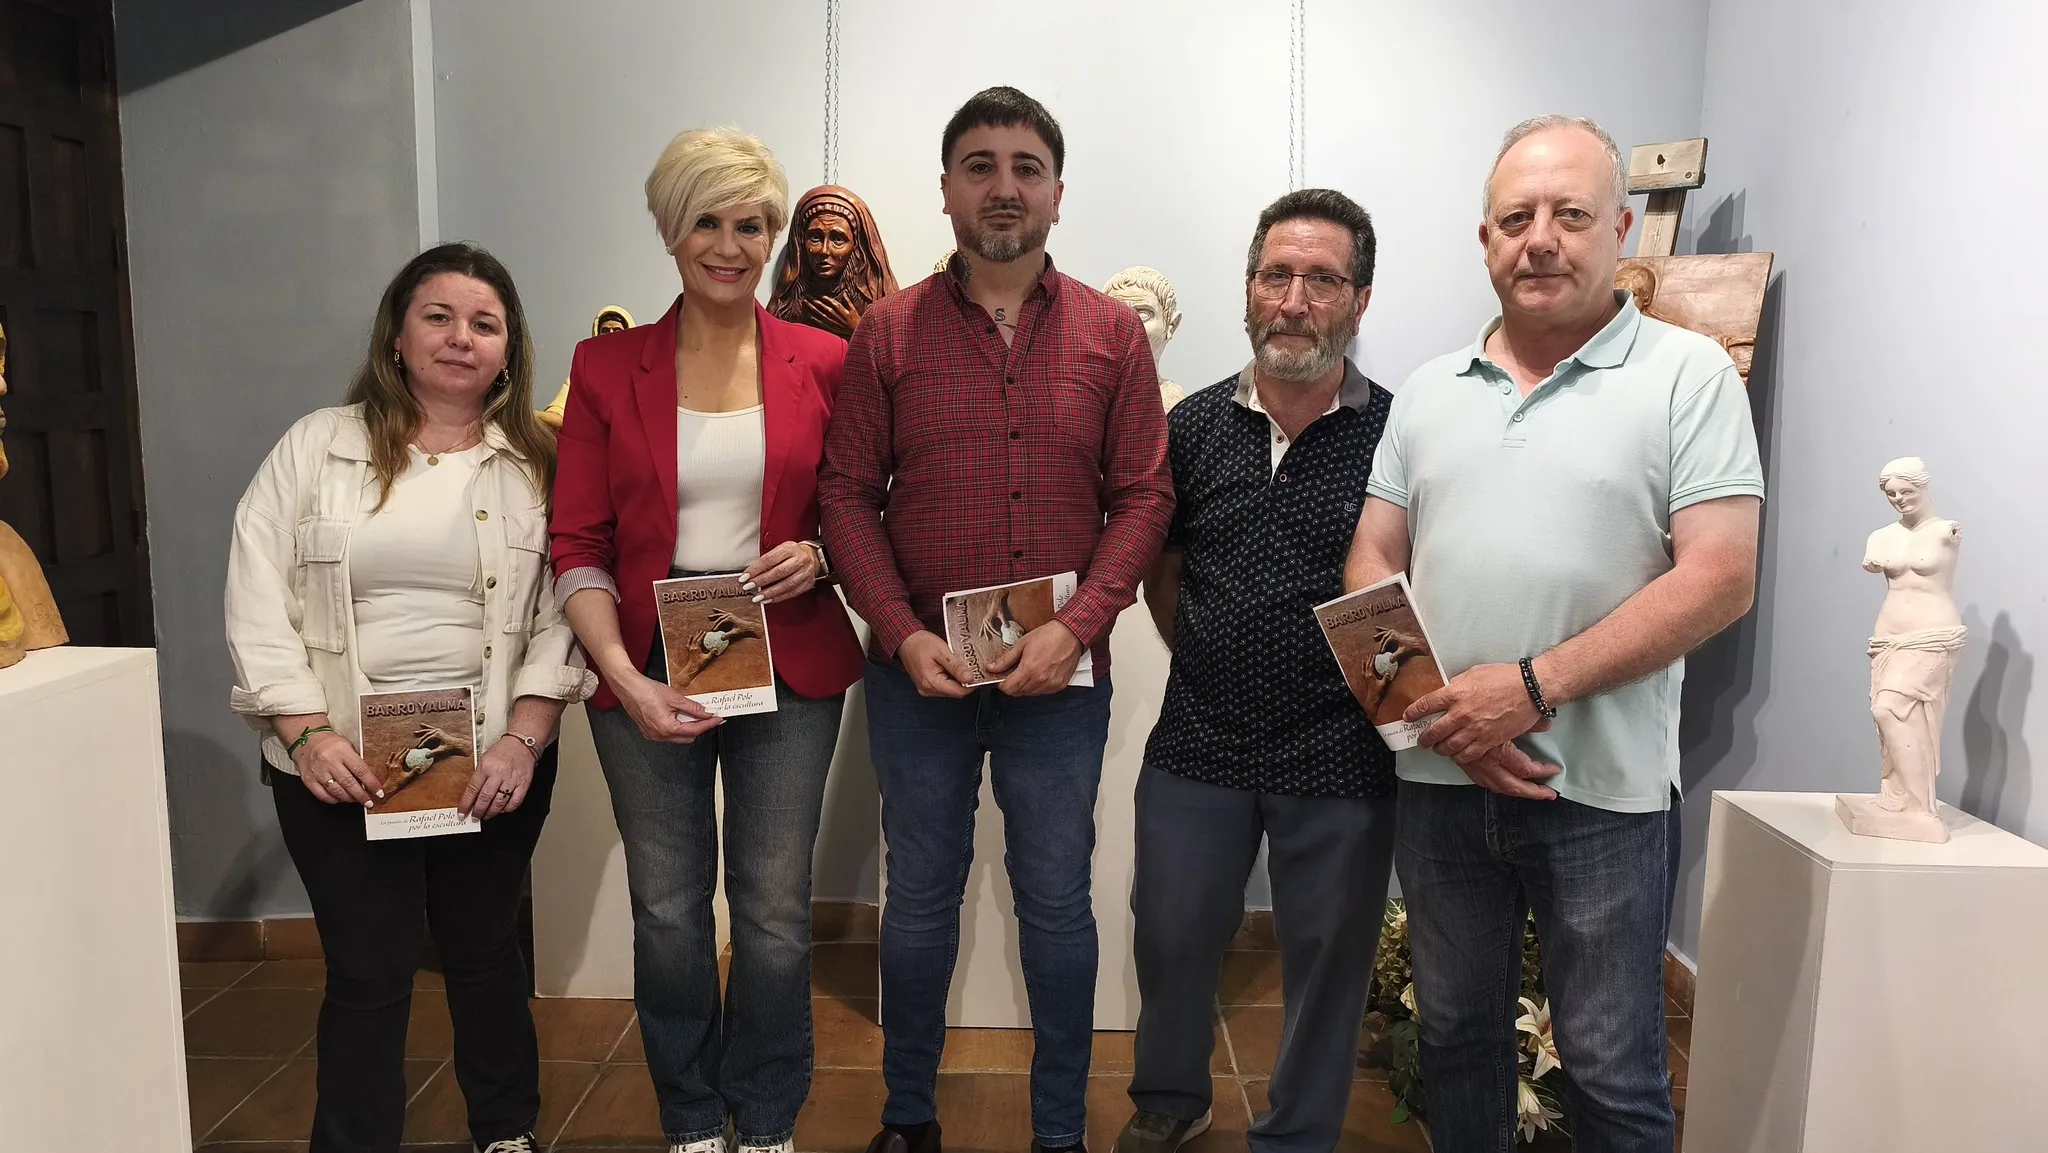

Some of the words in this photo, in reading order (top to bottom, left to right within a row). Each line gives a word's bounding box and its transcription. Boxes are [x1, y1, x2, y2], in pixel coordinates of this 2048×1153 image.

[718, 586, 754, 598] ALM
[711, 693, 736, 706] Rafael
[737, 692, 753, 701] Polo
[408, 813, 436, 825] Rafael
[437, 812, 455, 820] Polo
[432, 820, 466, 829] escultura
